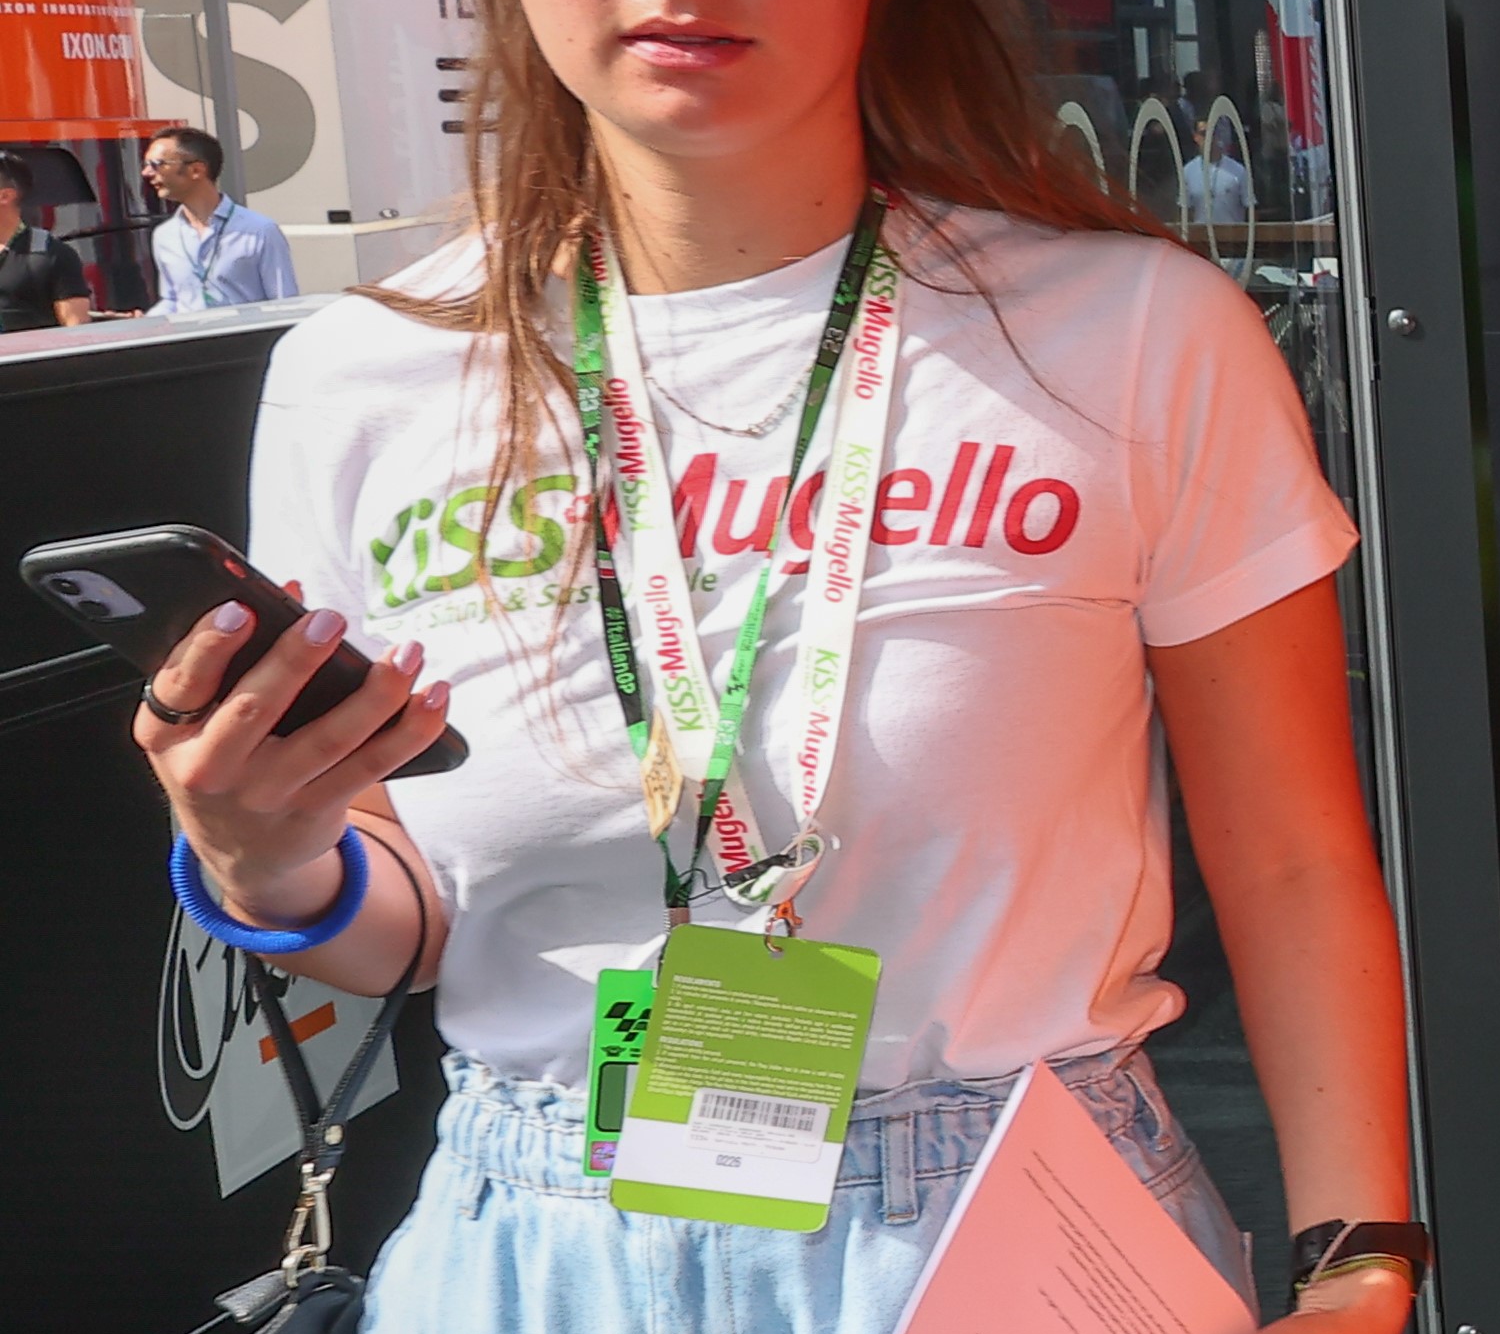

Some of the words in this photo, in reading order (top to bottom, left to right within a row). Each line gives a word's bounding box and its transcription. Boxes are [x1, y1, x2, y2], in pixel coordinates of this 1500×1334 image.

[853, 298, 895, 400] Mugello
[603, 377, 647, 478] Mugello
[824, 501, 864, 604] Mugello
[604, 606, 635, 696] #ItalianGP
[644, 574, 690, 672] Mugello
[664, 674, 704, 731] KiSS
